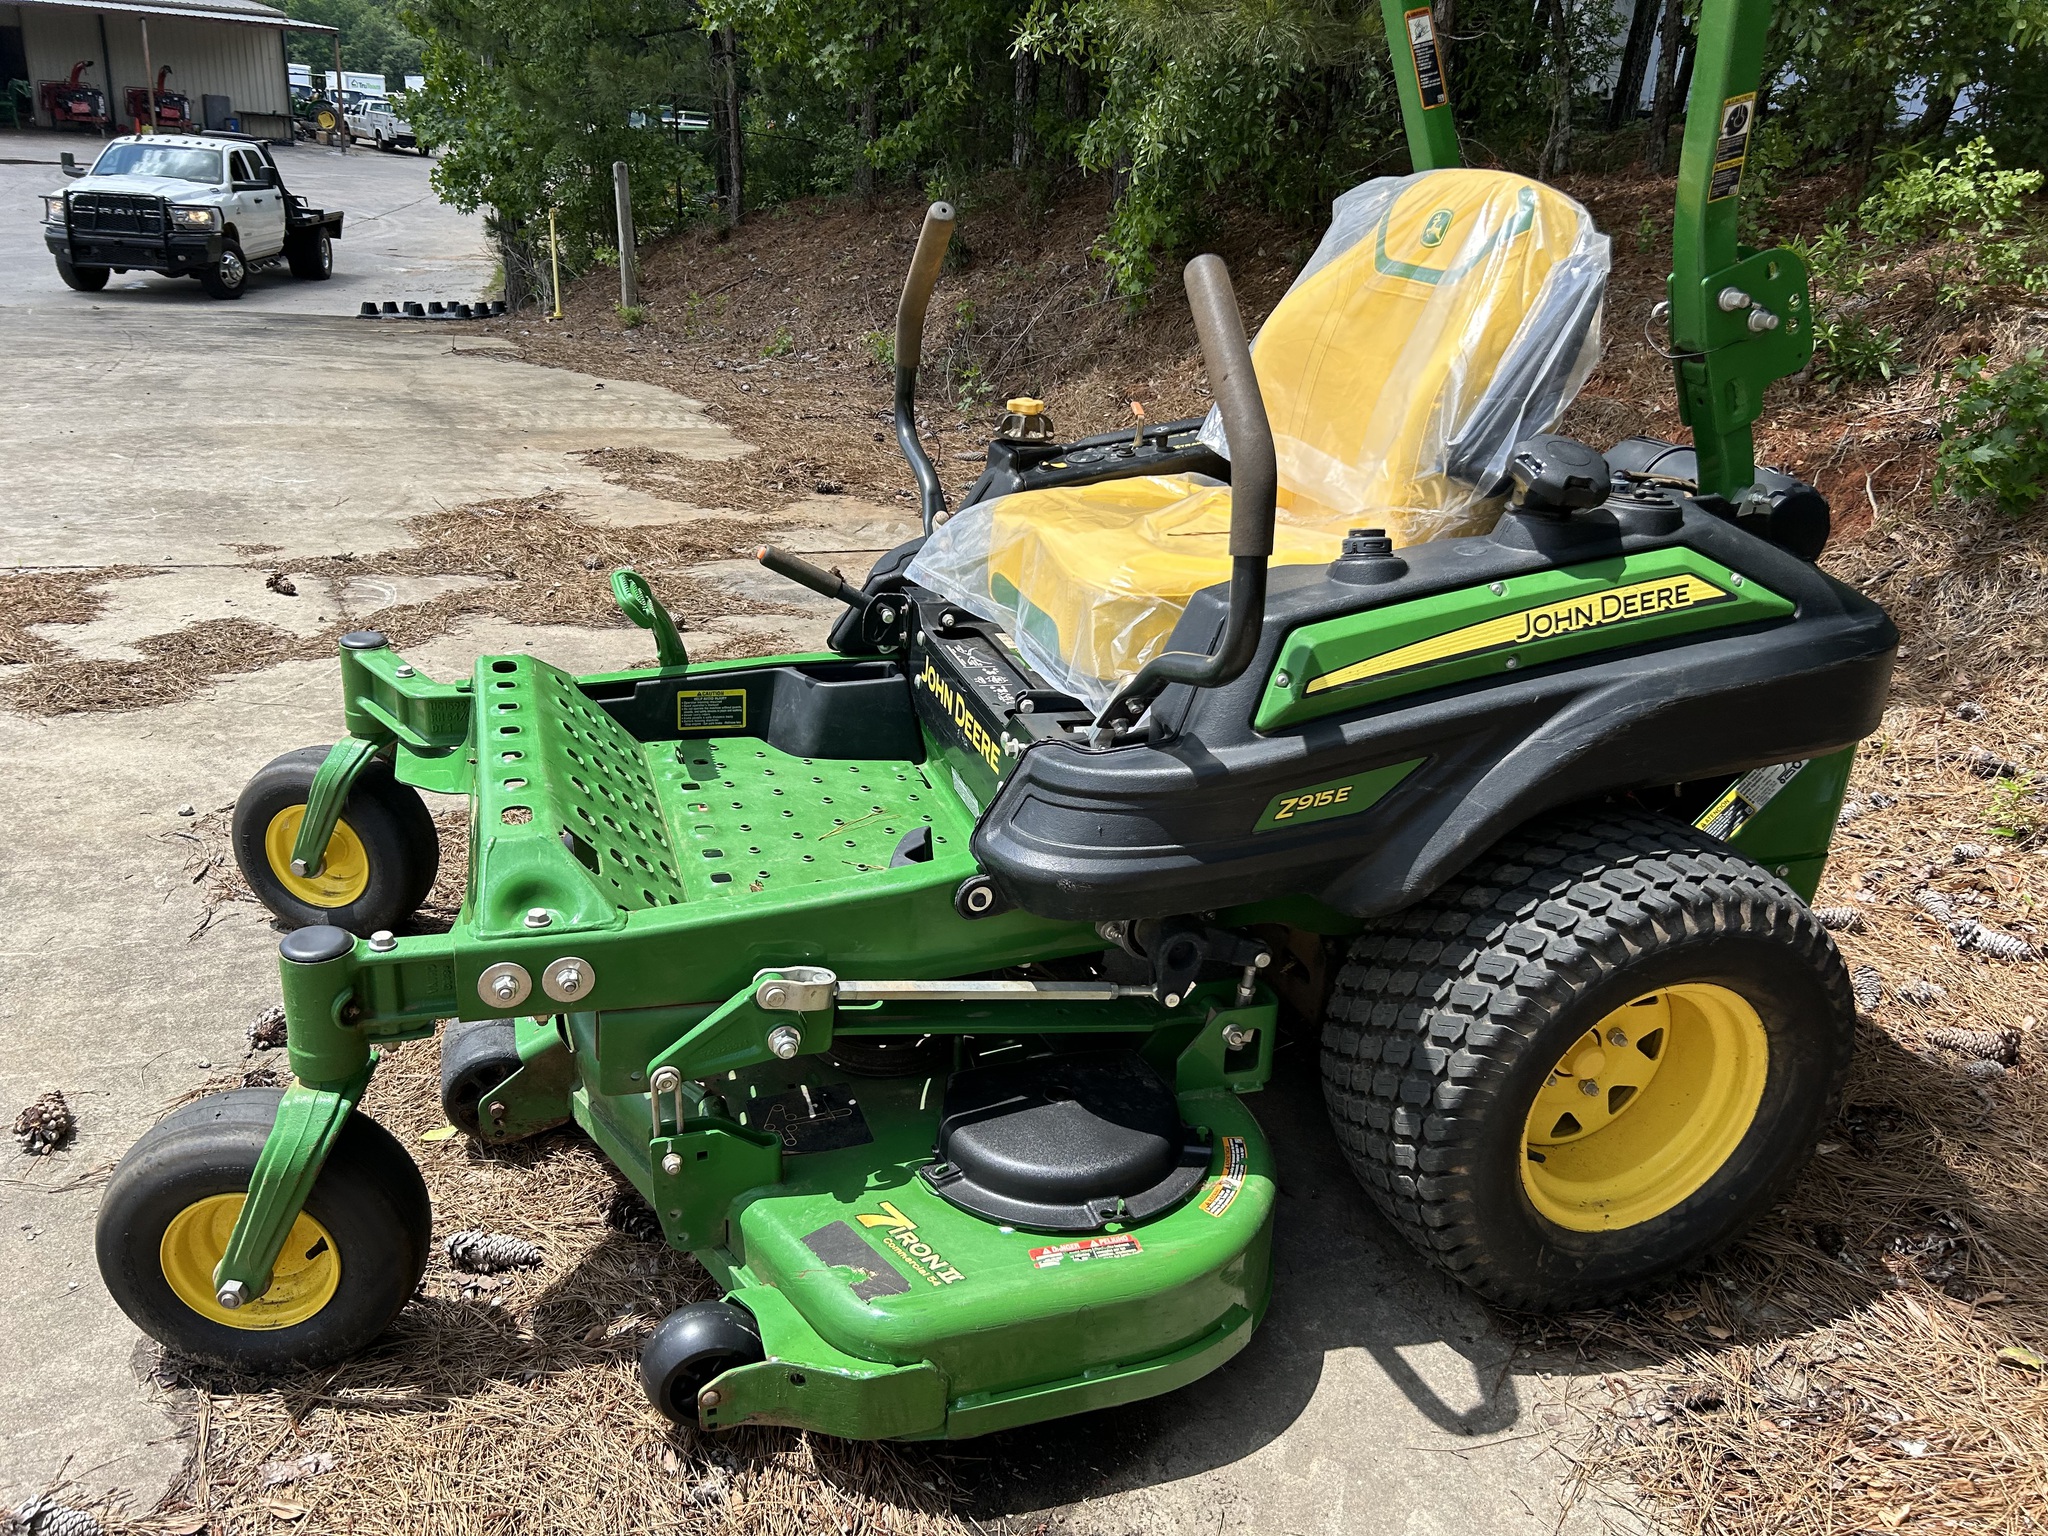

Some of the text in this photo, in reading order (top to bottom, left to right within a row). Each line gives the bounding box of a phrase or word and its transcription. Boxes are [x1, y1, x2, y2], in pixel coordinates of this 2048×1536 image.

[98, 207, 141, 216] RAM
[1516, 583, 1690, 640] JOHN DEERE
[921, 655, 953, 714] JOHN
[954, 692, 1001, 776] DEERE
[1274, 785, 1354, 821] Z915E
[882, 1236, 942, 1288] Commercial 54
